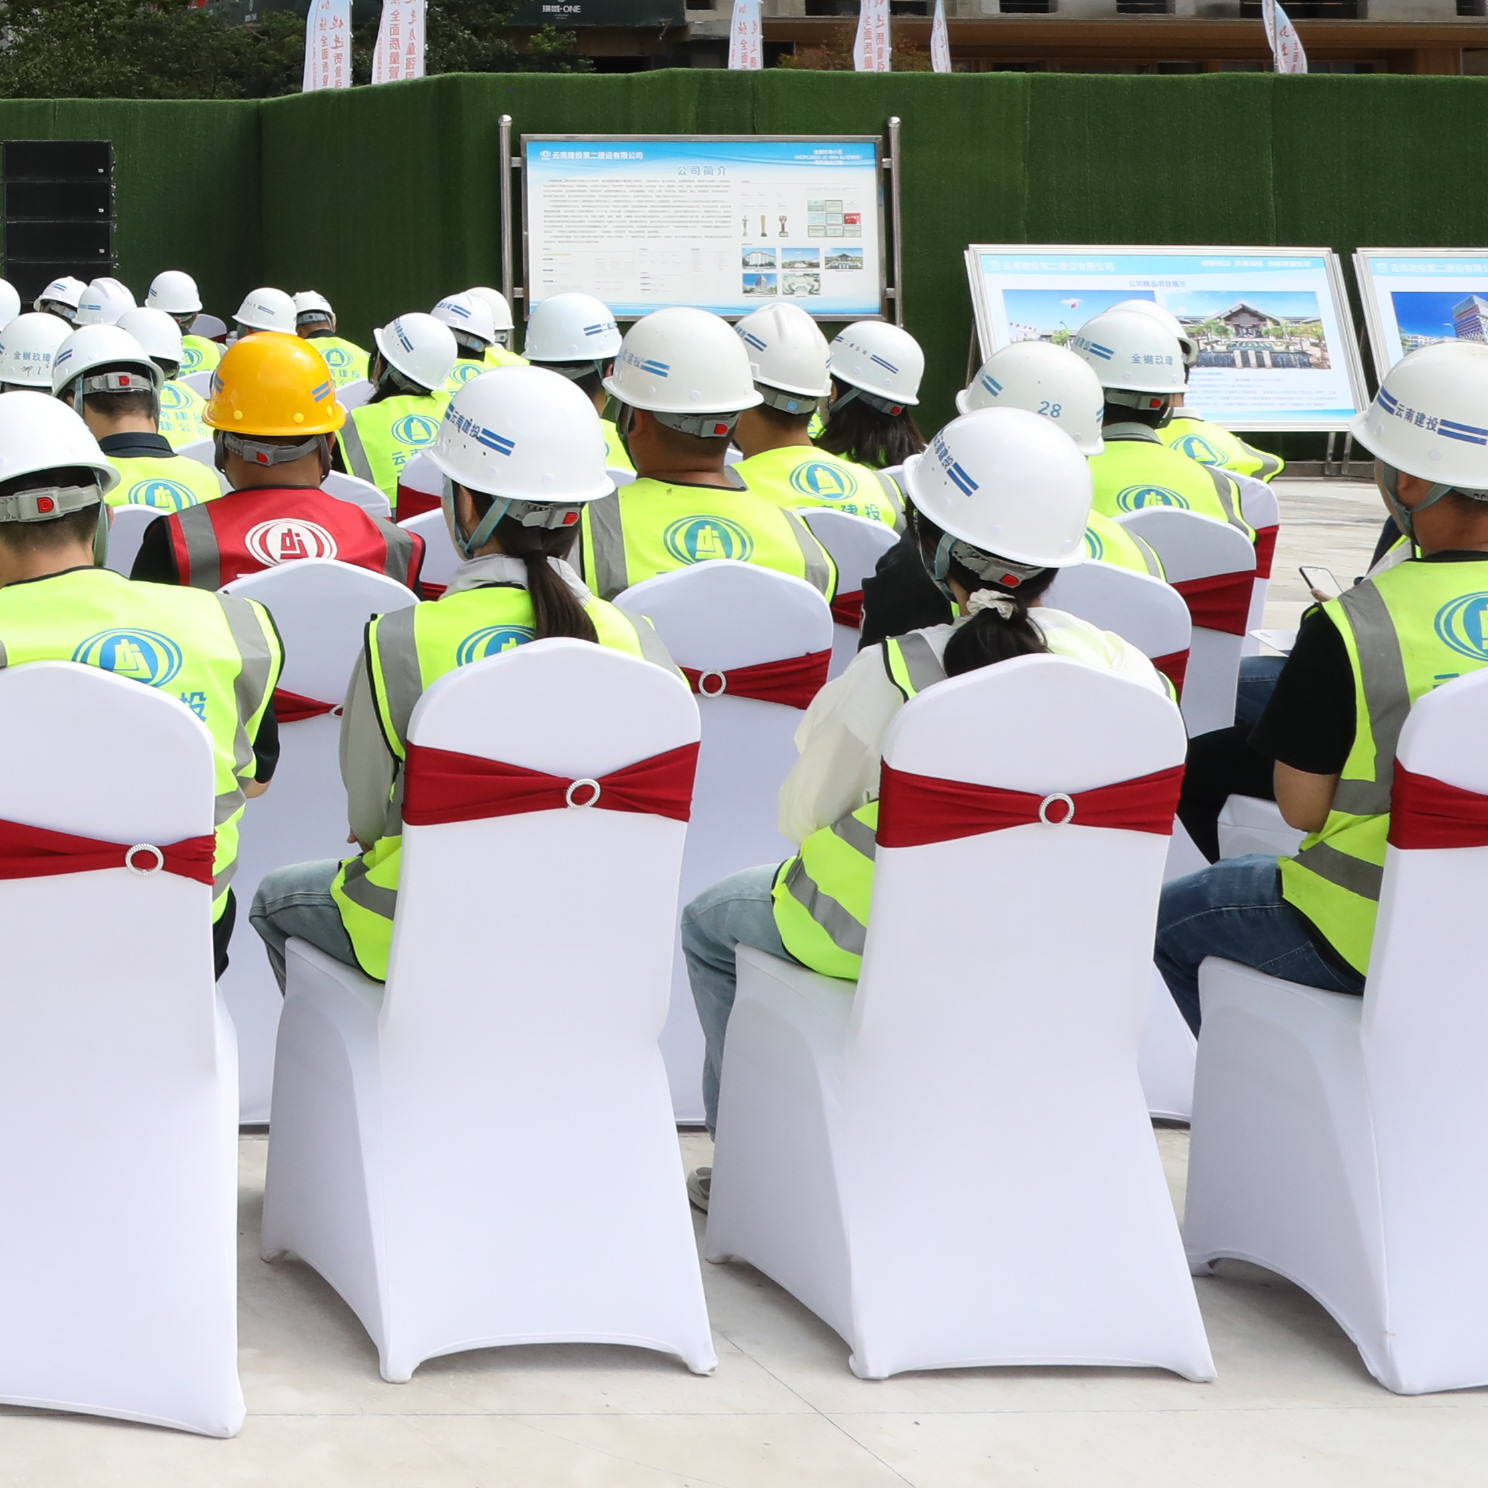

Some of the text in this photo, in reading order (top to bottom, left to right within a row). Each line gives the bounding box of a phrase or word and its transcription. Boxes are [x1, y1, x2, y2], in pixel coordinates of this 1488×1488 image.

[1037, 400, 1062, 419] 28
[1395, 403, 1439, 432] 云南建投
